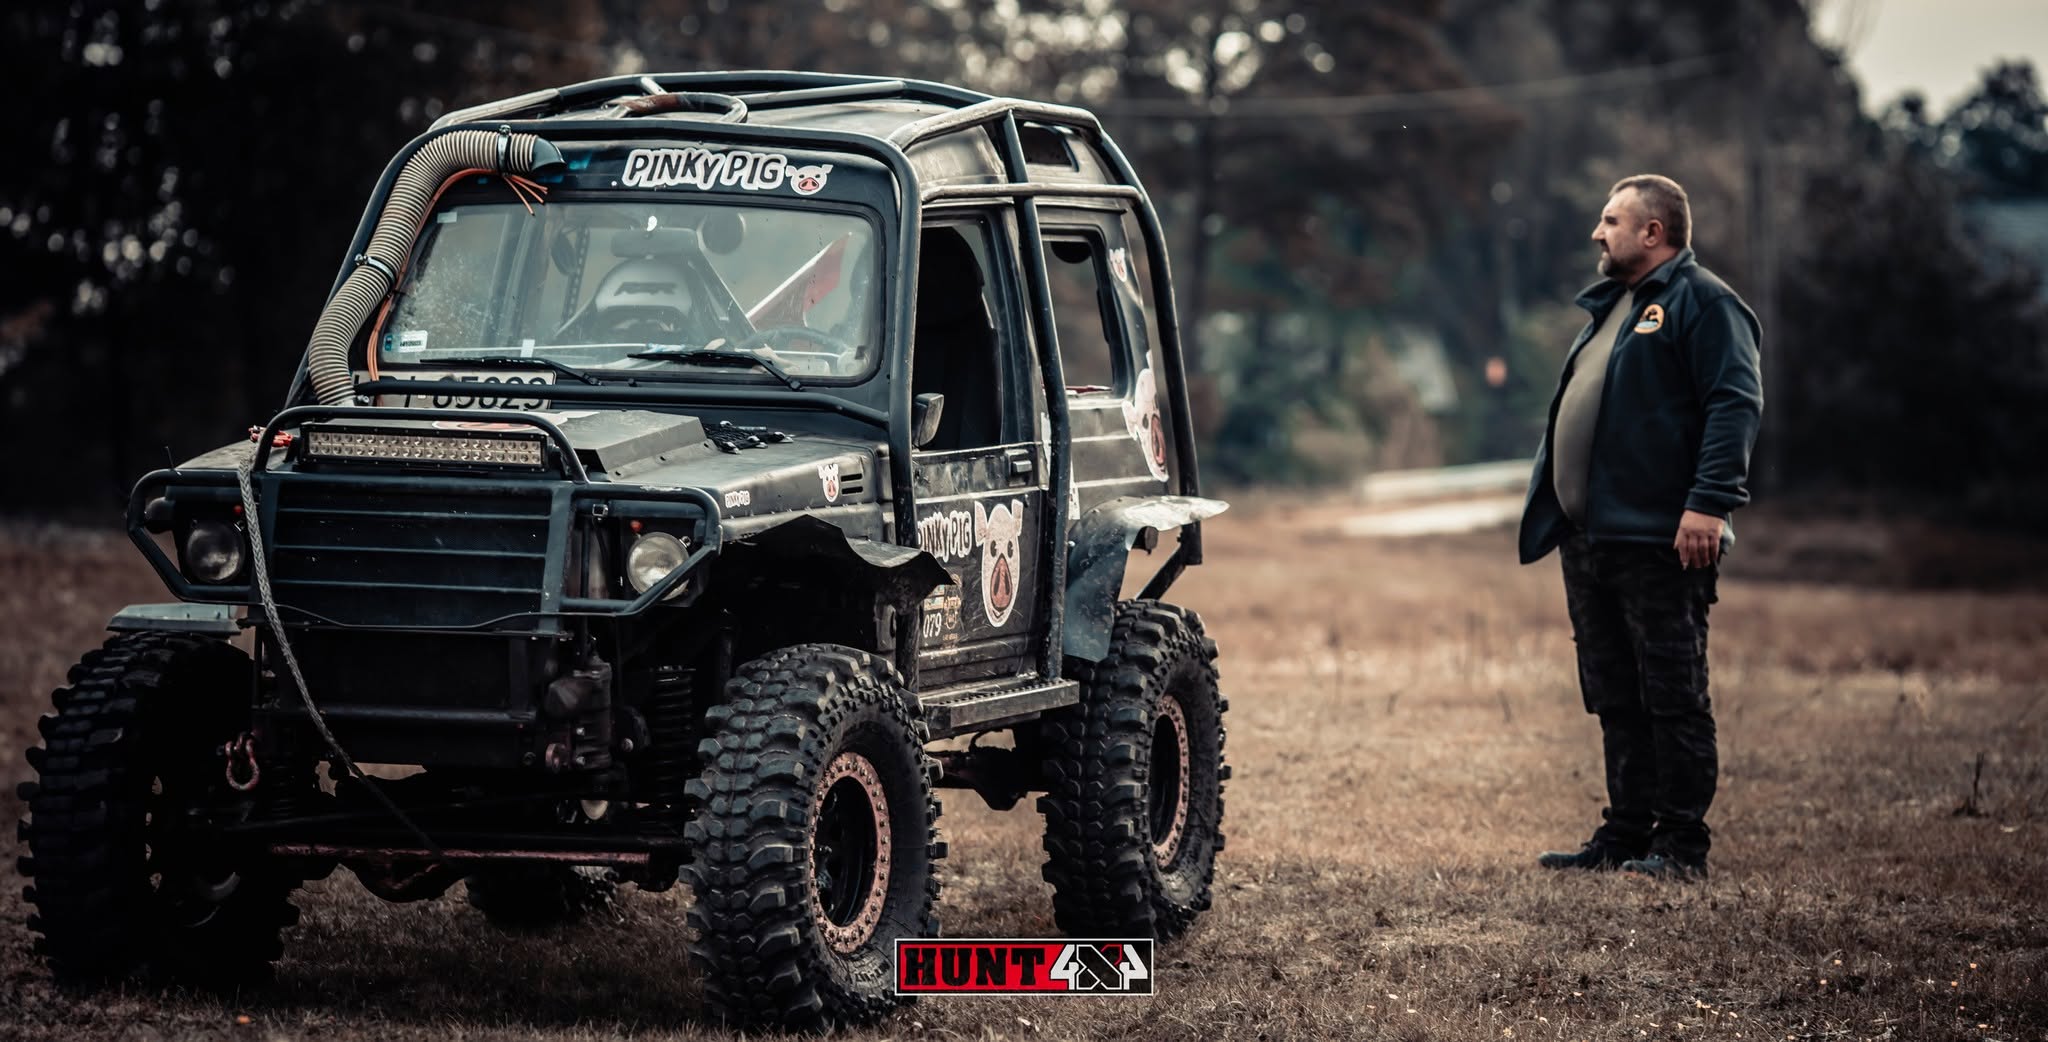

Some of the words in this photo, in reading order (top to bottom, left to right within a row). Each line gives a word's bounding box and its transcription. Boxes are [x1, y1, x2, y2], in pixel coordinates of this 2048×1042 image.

[625, 151, 722, 187] PINKY
[724, 151, 784, 187] PIG
[951, 513, 971, 555] PIG
[922, 612, 942, 639] 079
